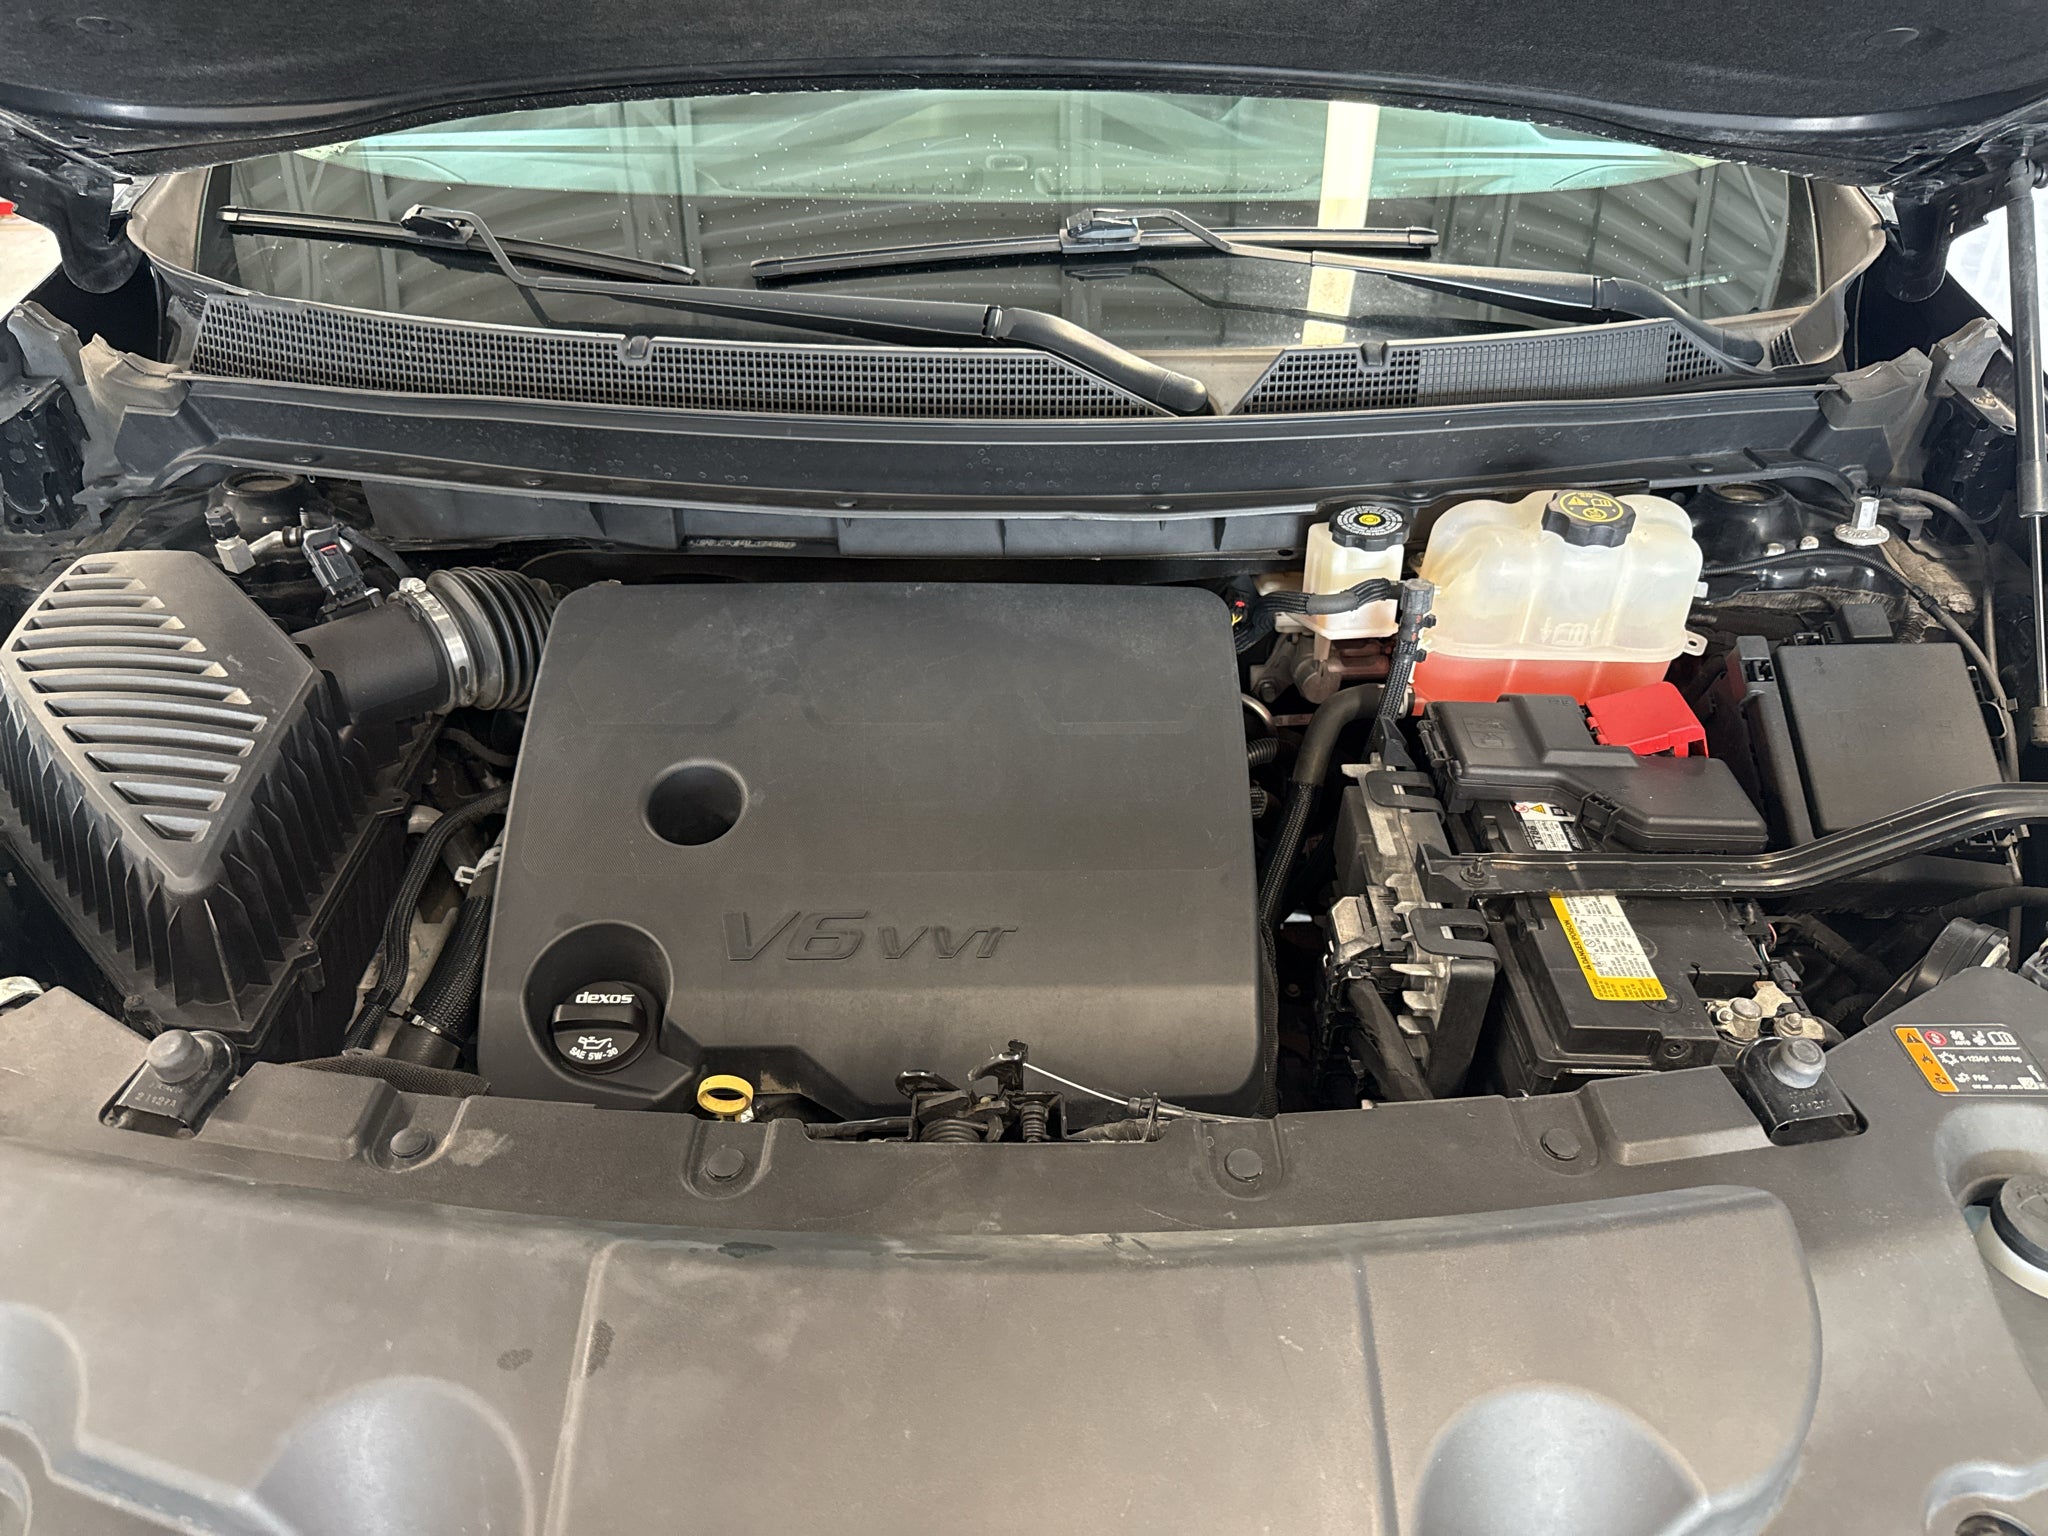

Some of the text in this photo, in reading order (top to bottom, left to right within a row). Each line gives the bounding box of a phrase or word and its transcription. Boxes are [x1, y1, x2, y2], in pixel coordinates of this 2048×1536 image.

[1528, 825, 1543, 845] 3786
[722, 910, 1018, 961] V6 VVT
[1563, 919, 1579, 940] POISON
[1573, 941, 1591, 965] DANGER
[575, 991, 635, 1004] dexos
[569, 1046, 618, 1060] SAE 5W-30
